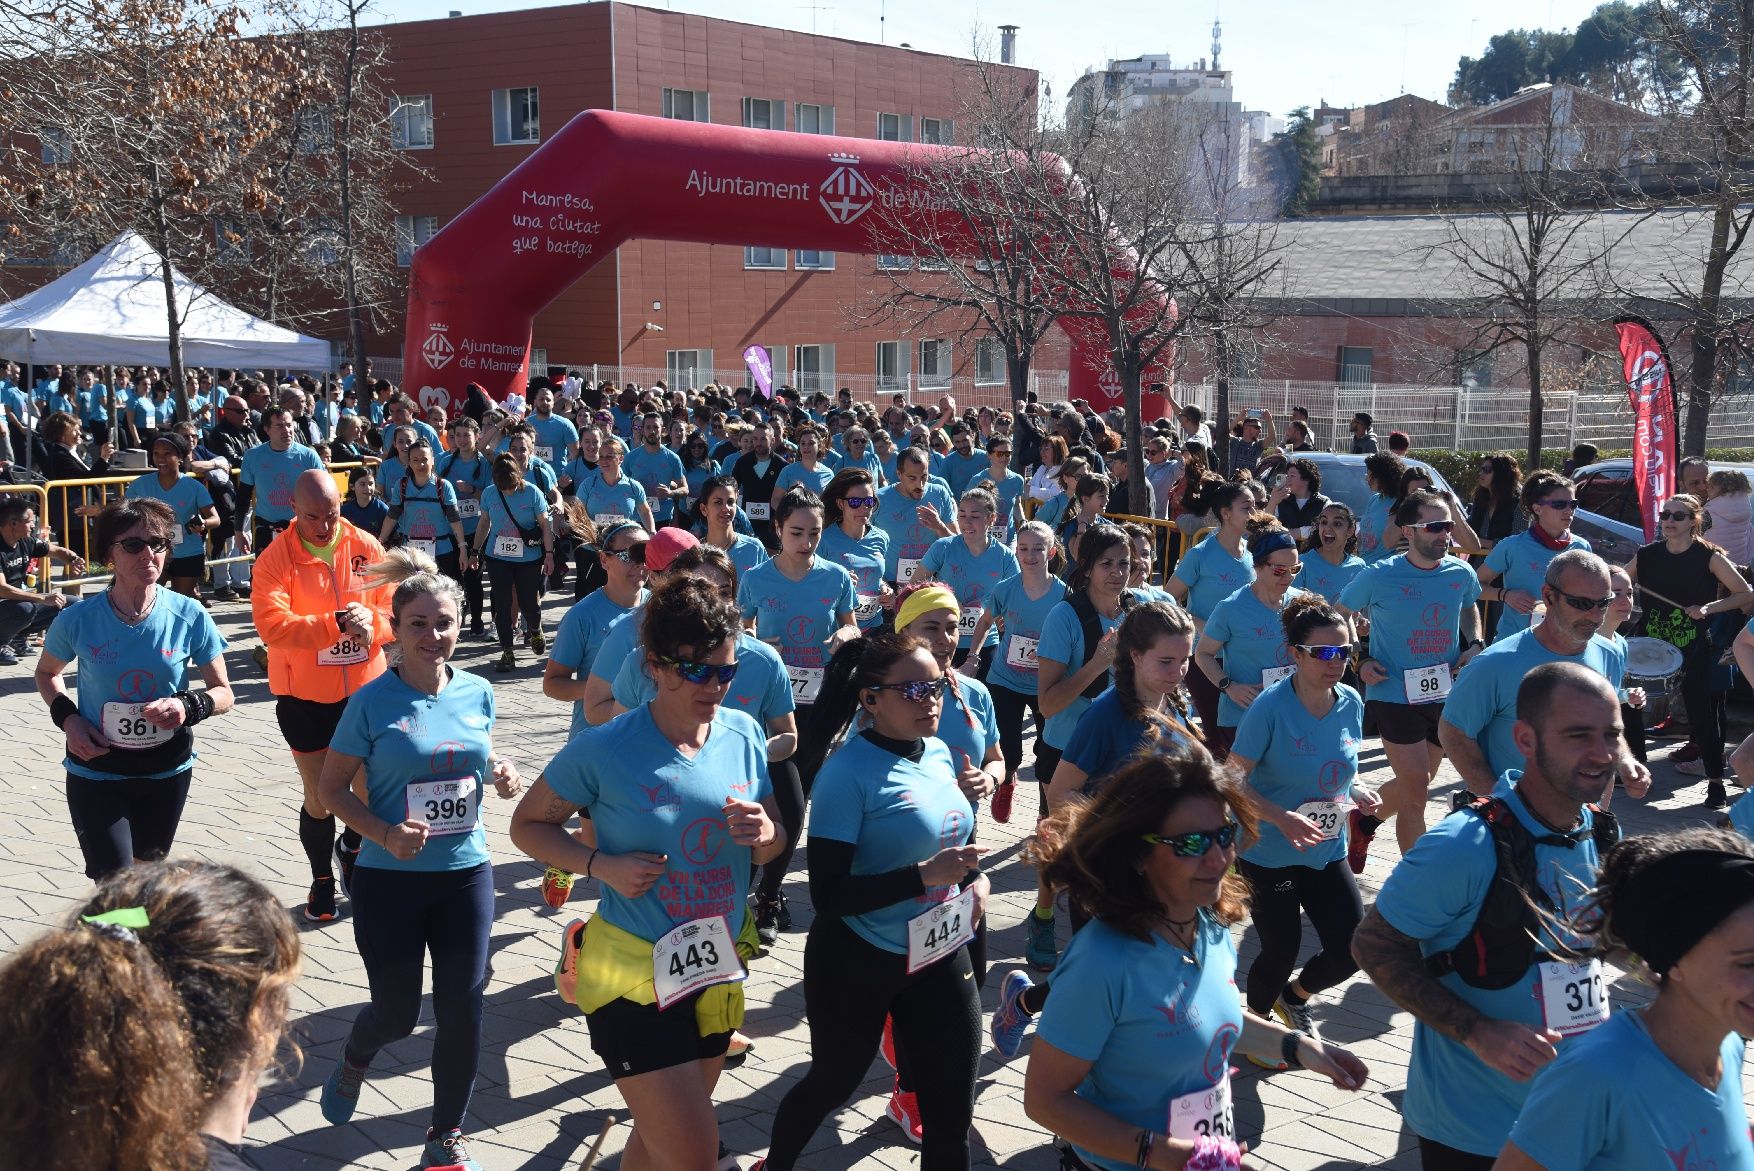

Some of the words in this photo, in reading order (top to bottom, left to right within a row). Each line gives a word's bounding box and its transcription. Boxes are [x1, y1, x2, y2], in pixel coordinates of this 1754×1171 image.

[685, 169, 810, 201] Ajuntament
[522, 190, 594, 212] Manresa,
[513, 214, 543, 228] una
[549, 213, 601, 234] ciutat
[512, 236, 539, 254] que
[547, 237, 593, 258] batega
[460, 338, 525, 356] Ajuntament
[459, 355, 476, 369] de
[480, 357, 524, 373] Manresa
[535, 449, 549, 459] 464
[459, 503, 476, 514] 149
[750, 507, 765, 516] 589
[501, 542, 518, 553] 182
[1420, 677, 1439, 693] 98
[424, 797, 468, 821] 396
[668, 870, 690, 886] VII
[692, 865, 733, 886] CURSA
[658, 885, 681, 901] DE
[683, 883, 706, 901] LA
[707, 880, 737, 899] DONA
[667, 899, 736, 918] MANRESA
[924, 913, 961, 949] 444
[669, 940, 719, 977] 443
